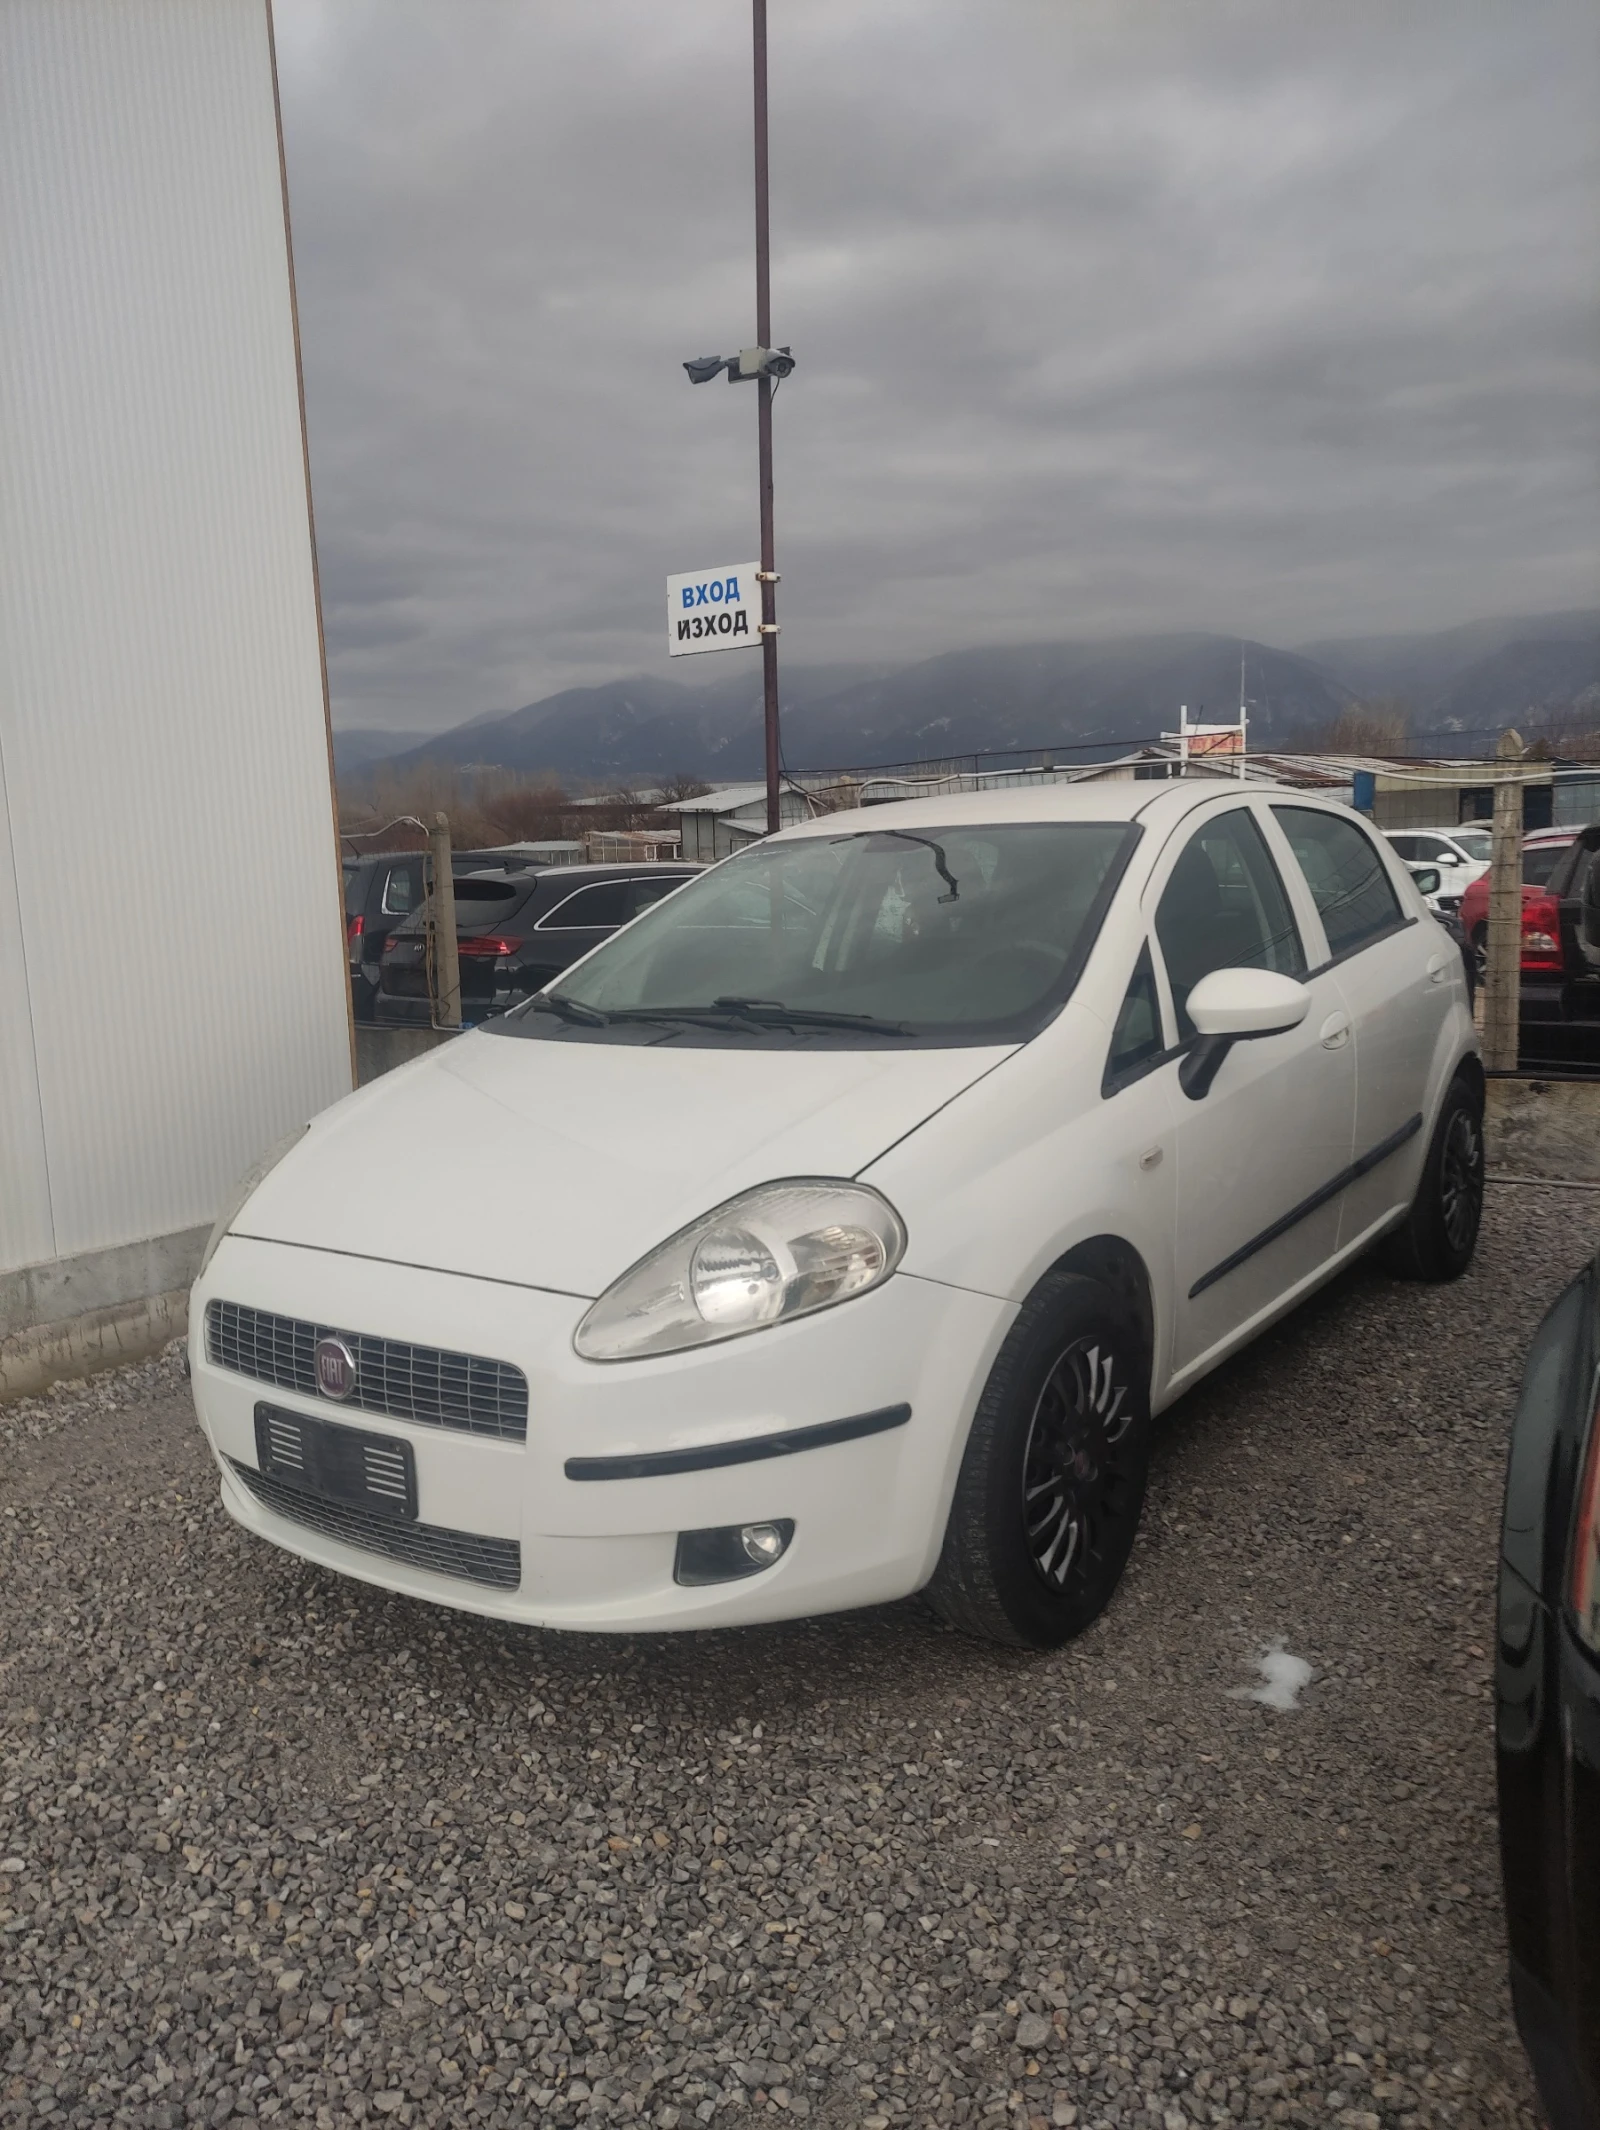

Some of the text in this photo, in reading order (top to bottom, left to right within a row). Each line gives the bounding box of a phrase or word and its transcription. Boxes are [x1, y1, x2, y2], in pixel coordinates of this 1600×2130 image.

[682, 577, 740, 608] ВХОД
[678, 610, 748, 640] ИЗХОД
[321, 1354, 343, 1384] FIAT
